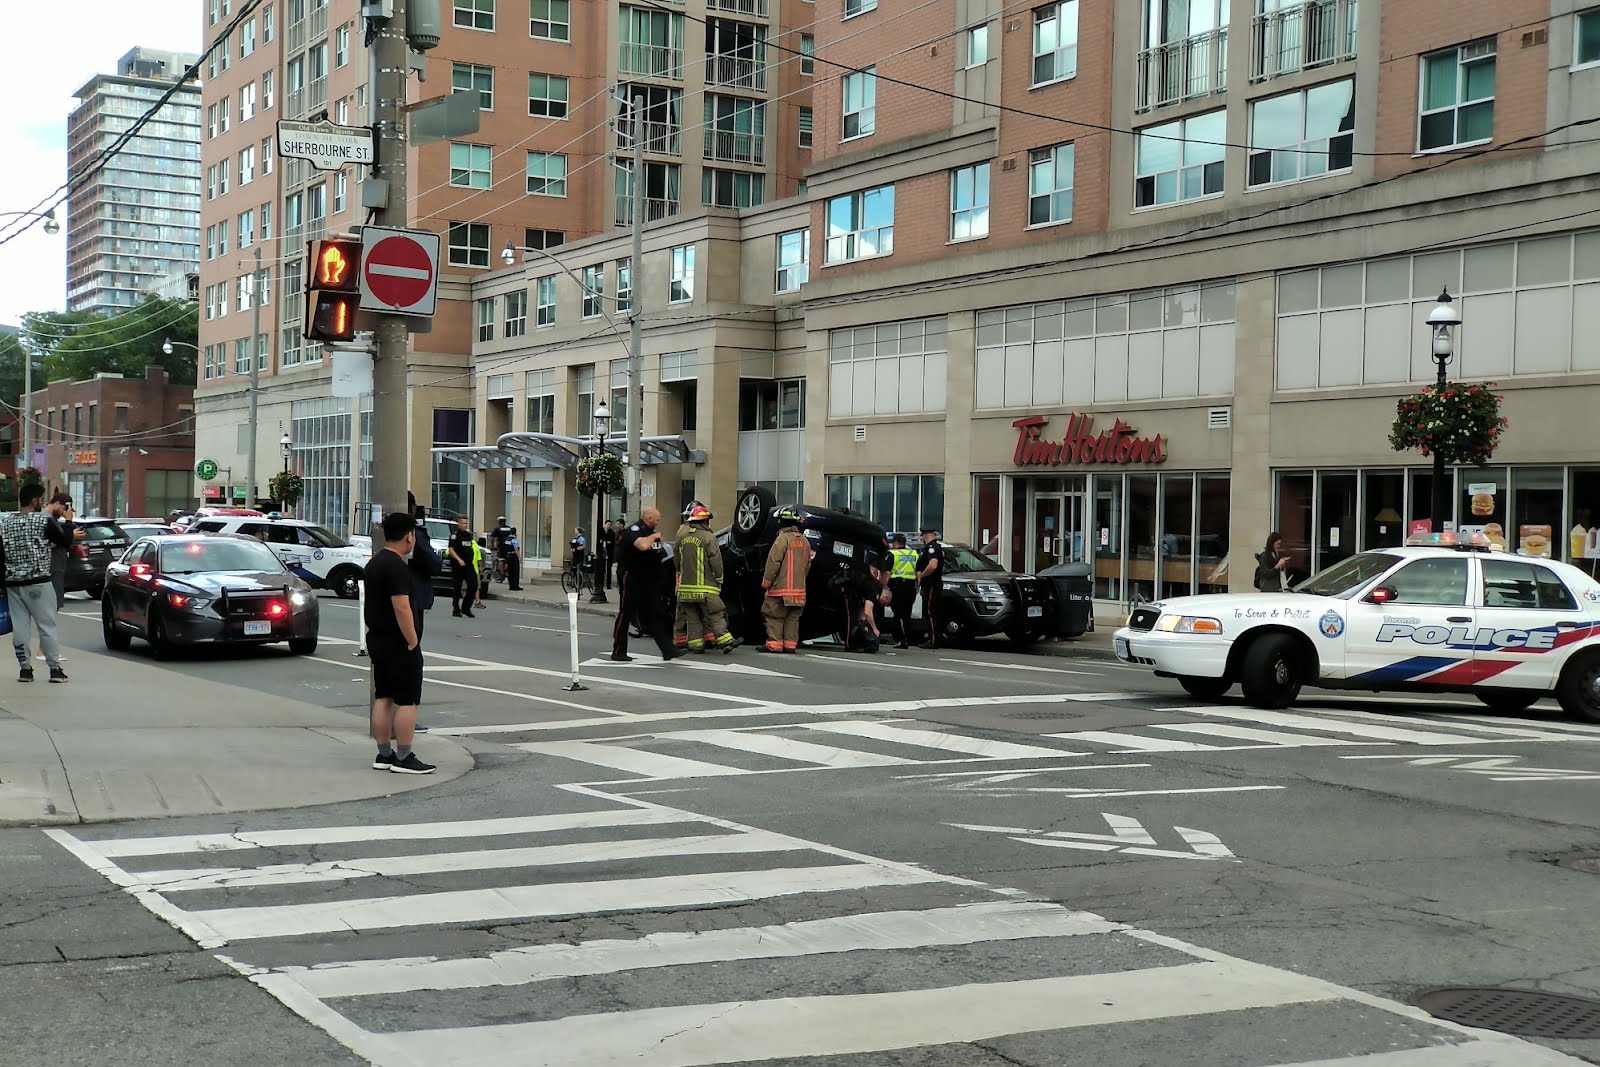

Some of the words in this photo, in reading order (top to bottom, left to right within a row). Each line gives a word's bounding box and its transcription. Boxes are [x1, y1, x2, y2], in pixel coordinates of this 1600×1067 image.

[337, 136, 359, 144] YORK
[284, 140, 352, 159] SHERBOURNE
[356, 147, 370, 160] ST.
[1012, 415, 1061, 466] Tim
[1060, 411, 1166, 465] Hortons
[203, 464, 212, 473] P
[1234, 608, 1243, 619] To
[1246, 608, 1267, 619] Serve
[1271, 608, 1280, 618] &
[1284, 607, 1312, 619] Protect
[1383, 615, 1422, 625] Toronto
[1375, 623, 1560, 649] POLICE
